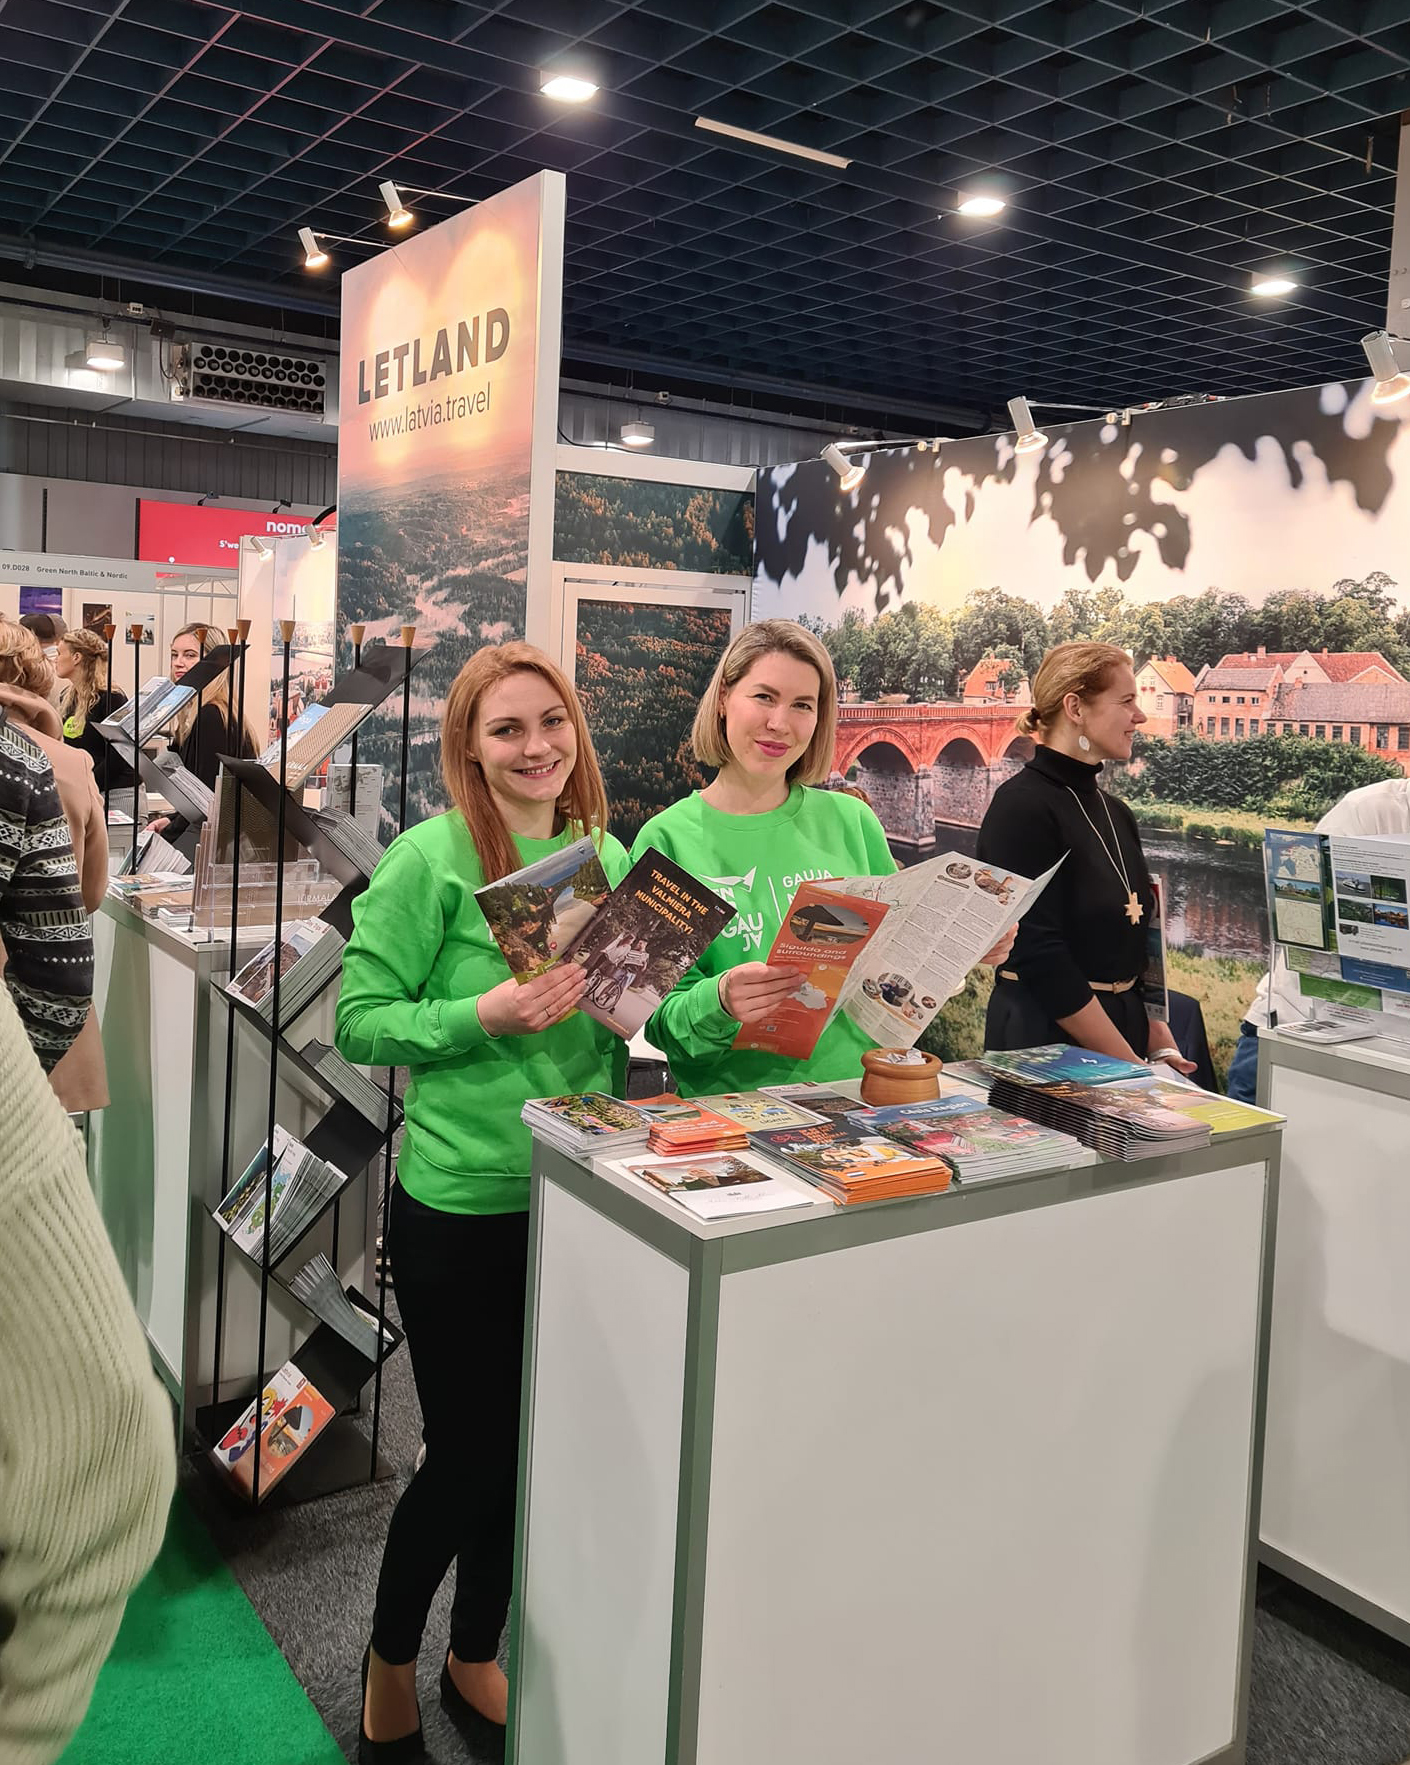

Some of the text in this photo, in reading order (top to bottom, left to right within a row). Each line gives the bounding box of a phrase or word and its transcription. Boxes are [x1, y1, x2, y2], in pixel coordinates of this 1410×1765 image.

[358, 307, 510, 405] LETLAND
[369, 382, 491, 442] www.latvia.travel
[2, 563, 30, 572] 09.D028
[36, 566, 58, 574] Green
[59, 568, 78, 576] North
[80, 569, 98, 577] Baltic
[106, 571, 128, 580] Nordic
[650, 868, 681, 896] TRAVEL
[680, 891, 692, 903] IN
[690, 898, 709, 916] THE
[782, 868, 834, 888] GAUJA
[634, 889, 694, 935] MUNICIPALITY!
[651, 885, 692, 919] VALMIERA
[720, 912, 764, 938] GAU
[779, 942, 822, 954] Sigulda
